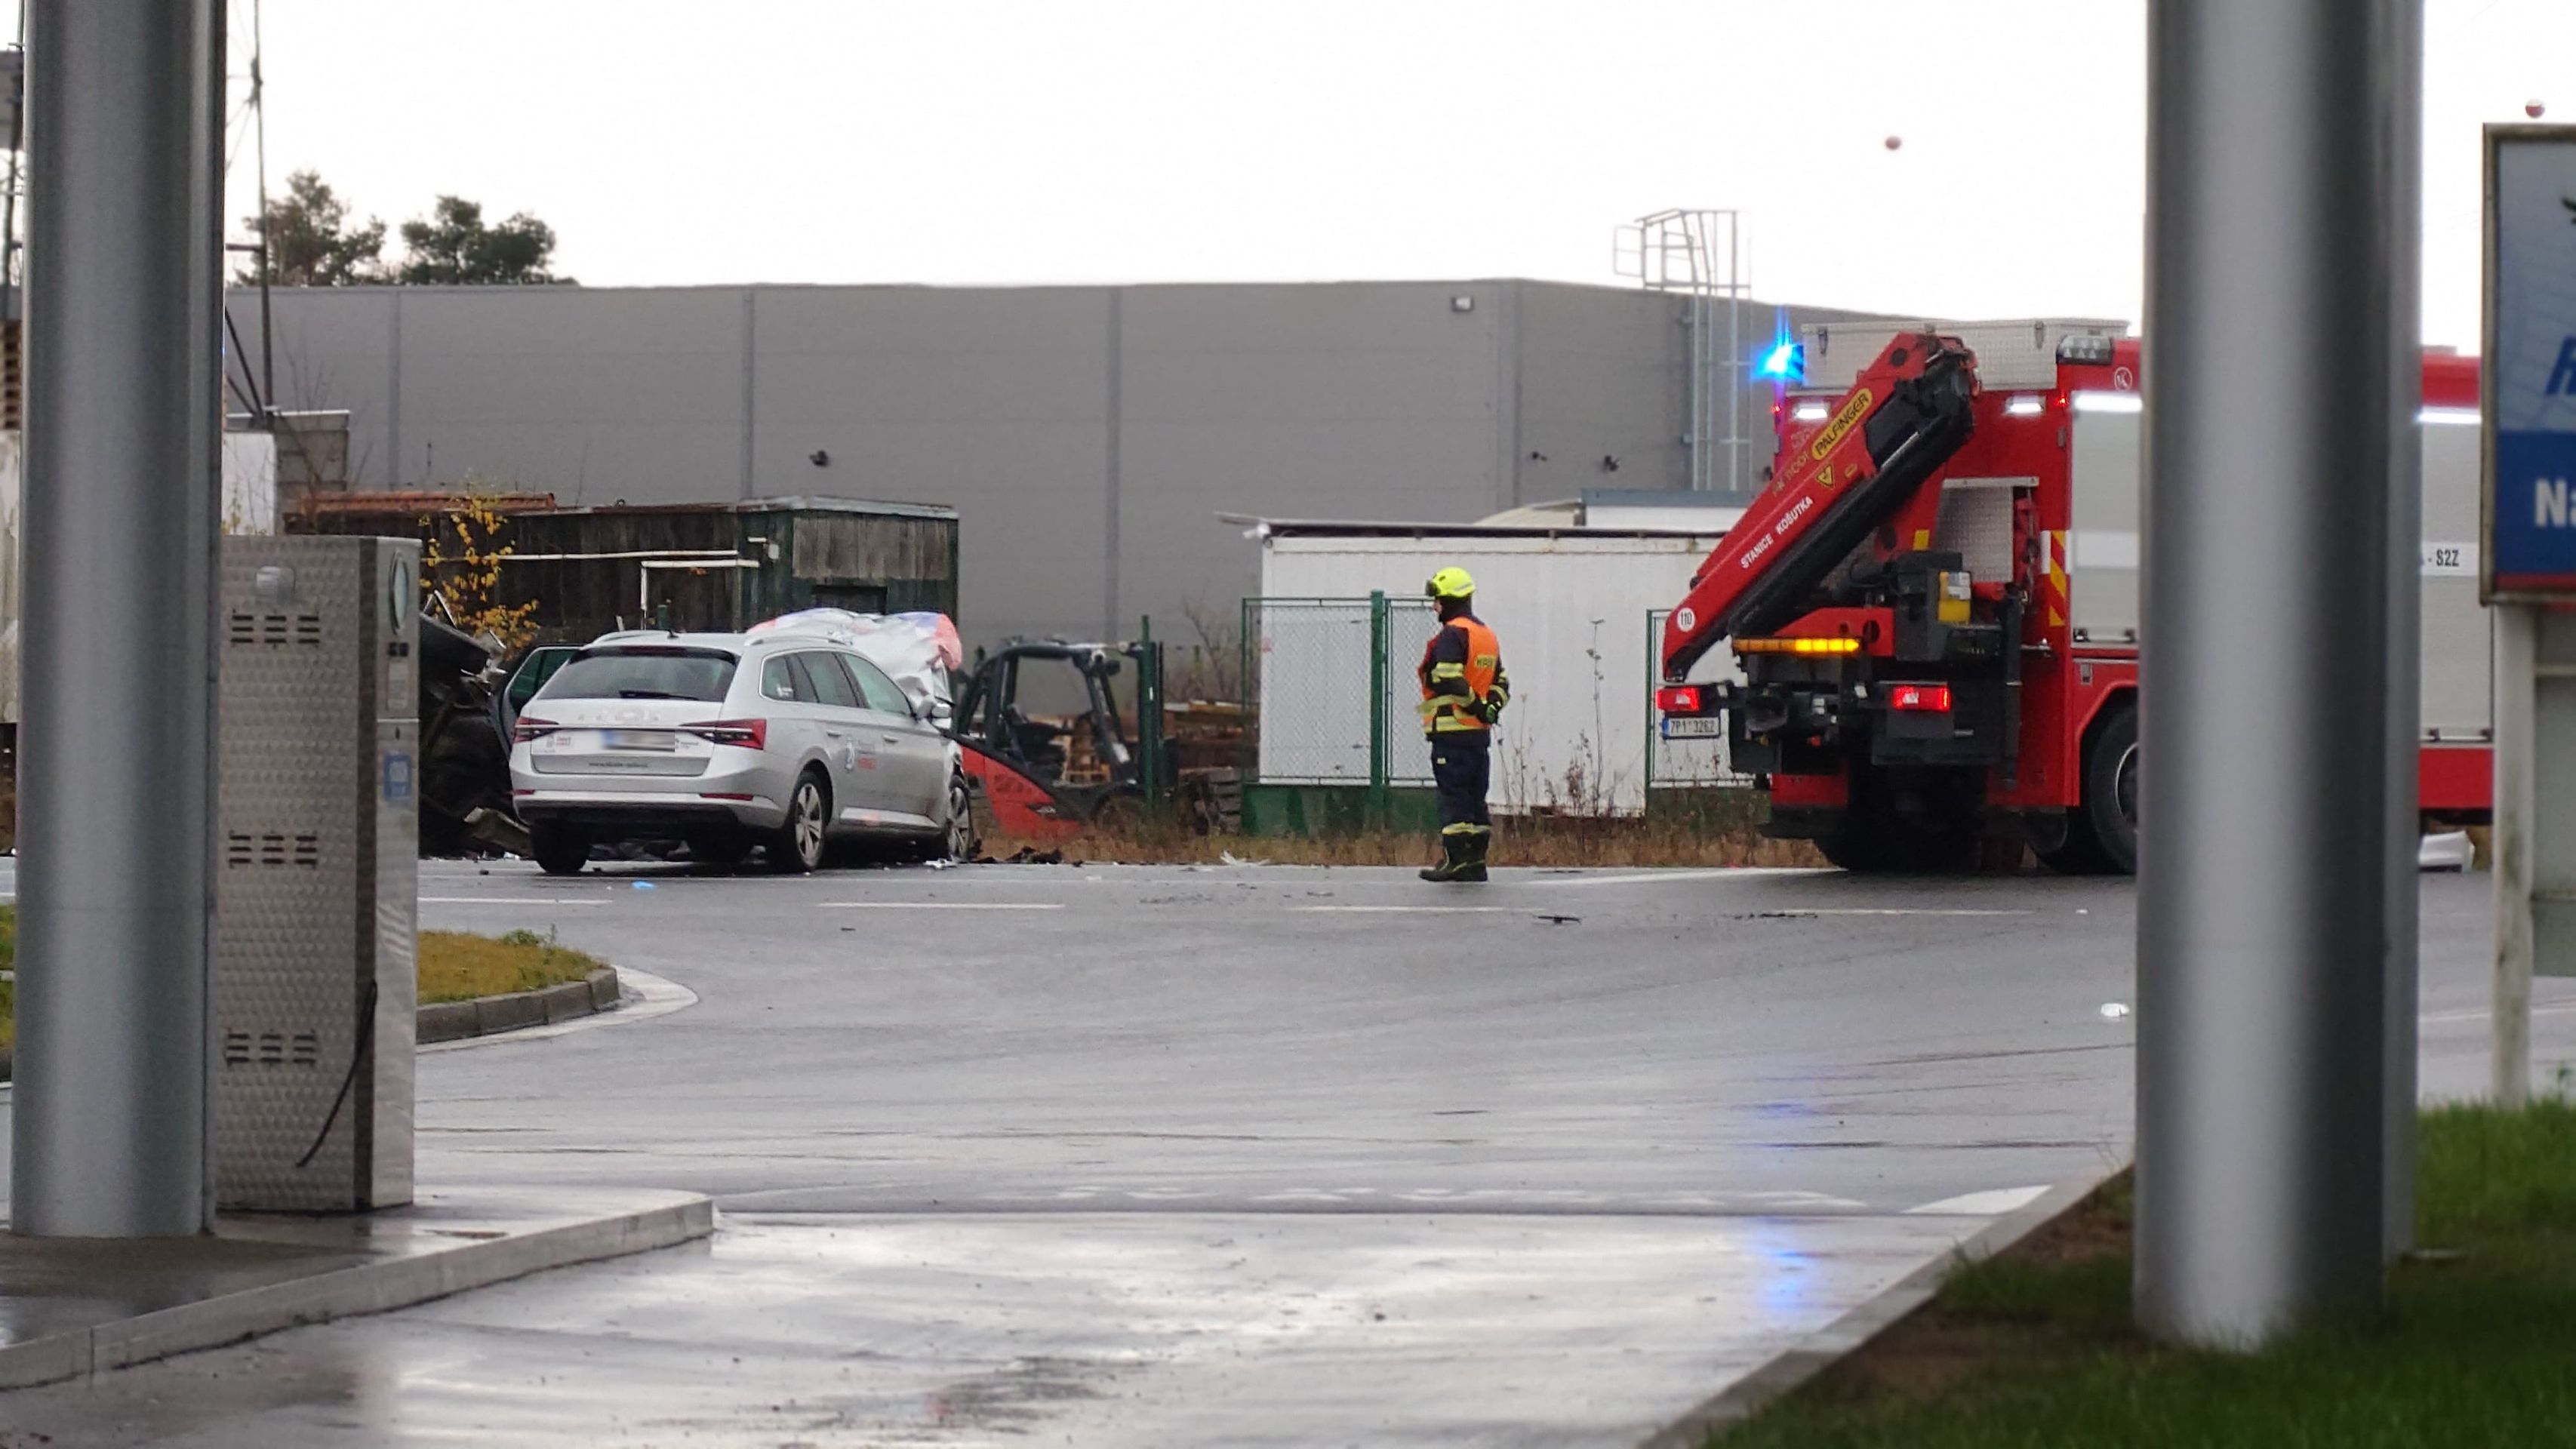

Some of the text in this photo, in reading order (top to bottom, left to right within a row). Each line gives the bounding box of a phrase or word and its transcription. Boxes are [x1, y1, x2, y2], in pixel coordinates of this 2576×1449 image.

[1814, 392, 1870, 456] PALFINGER
[2534, 478, 2576, 528] N
[1740, 496, 1813, 568] STANICE KOŠUTKA
[1680, 612, 1693, 628] 110
